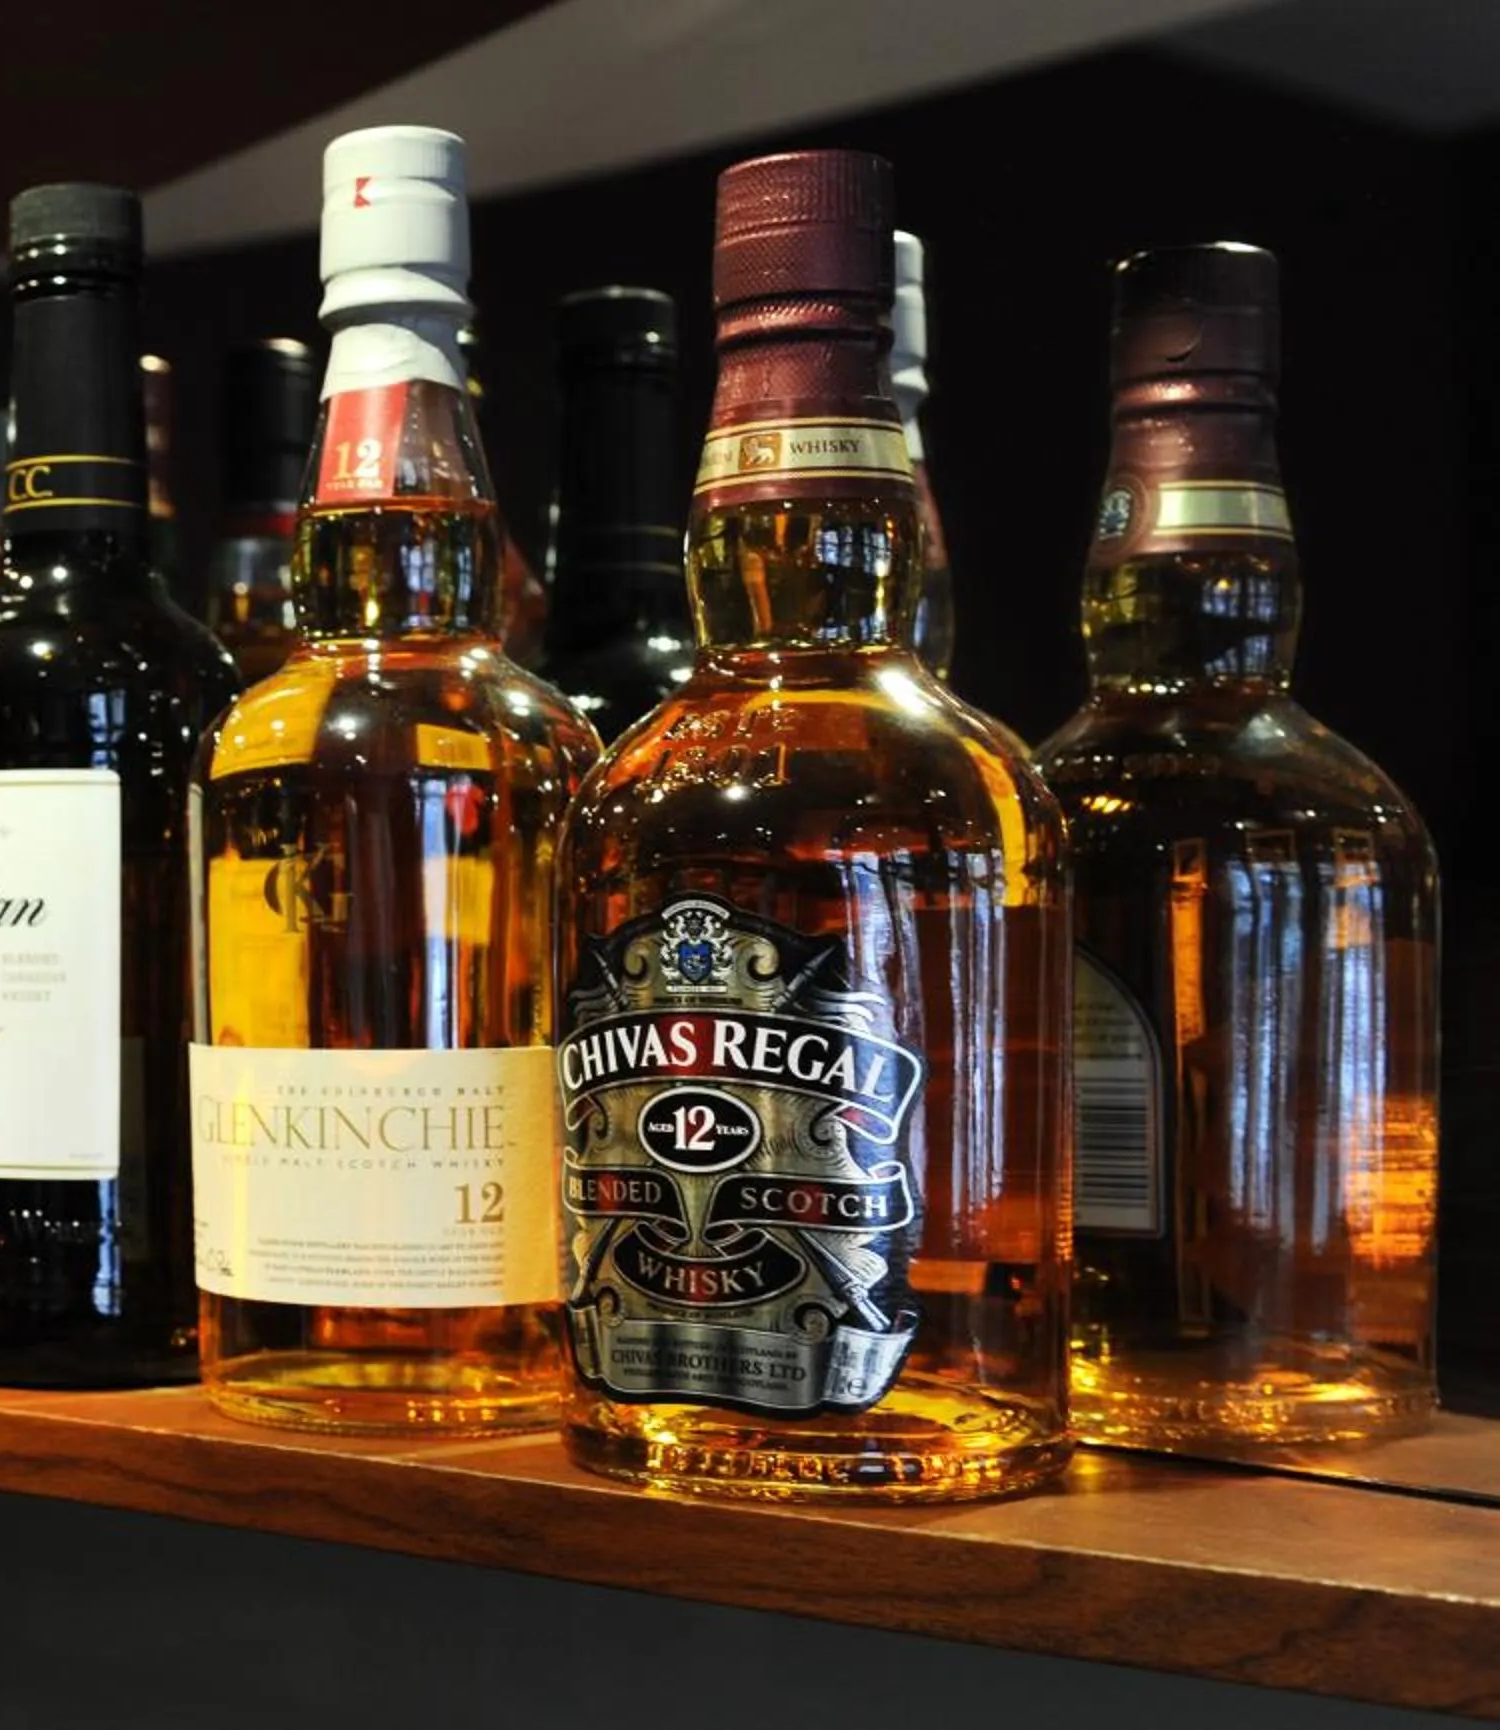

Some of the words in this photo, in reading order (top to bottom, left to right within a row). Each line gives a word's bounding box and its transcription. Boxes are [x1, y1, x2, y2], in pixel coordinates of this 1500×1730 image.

[331, 438, 381, 479] 12
[789, 439, 861, 455] WHISKY
[562, 1020, 697, 1091] CHIVAS
[711, 1018, 896, 1103] REGAL
[197, 1093, 506, 1153] GLENKINCHIE
[647, 1121, 675, 1133] AGED
[672, 1104, 716, 1151] 12
[715, 1123, 750, 1136] YEARS
[453, 1181, 506, 1225] 12
[567, 1175, 663, 1204] BLENDED
[739, 1186, 889, 1219] SCOTCH
[636, 1251, 766, 1296] WHISKY
[768, 1365, 808, 1382] LTD
